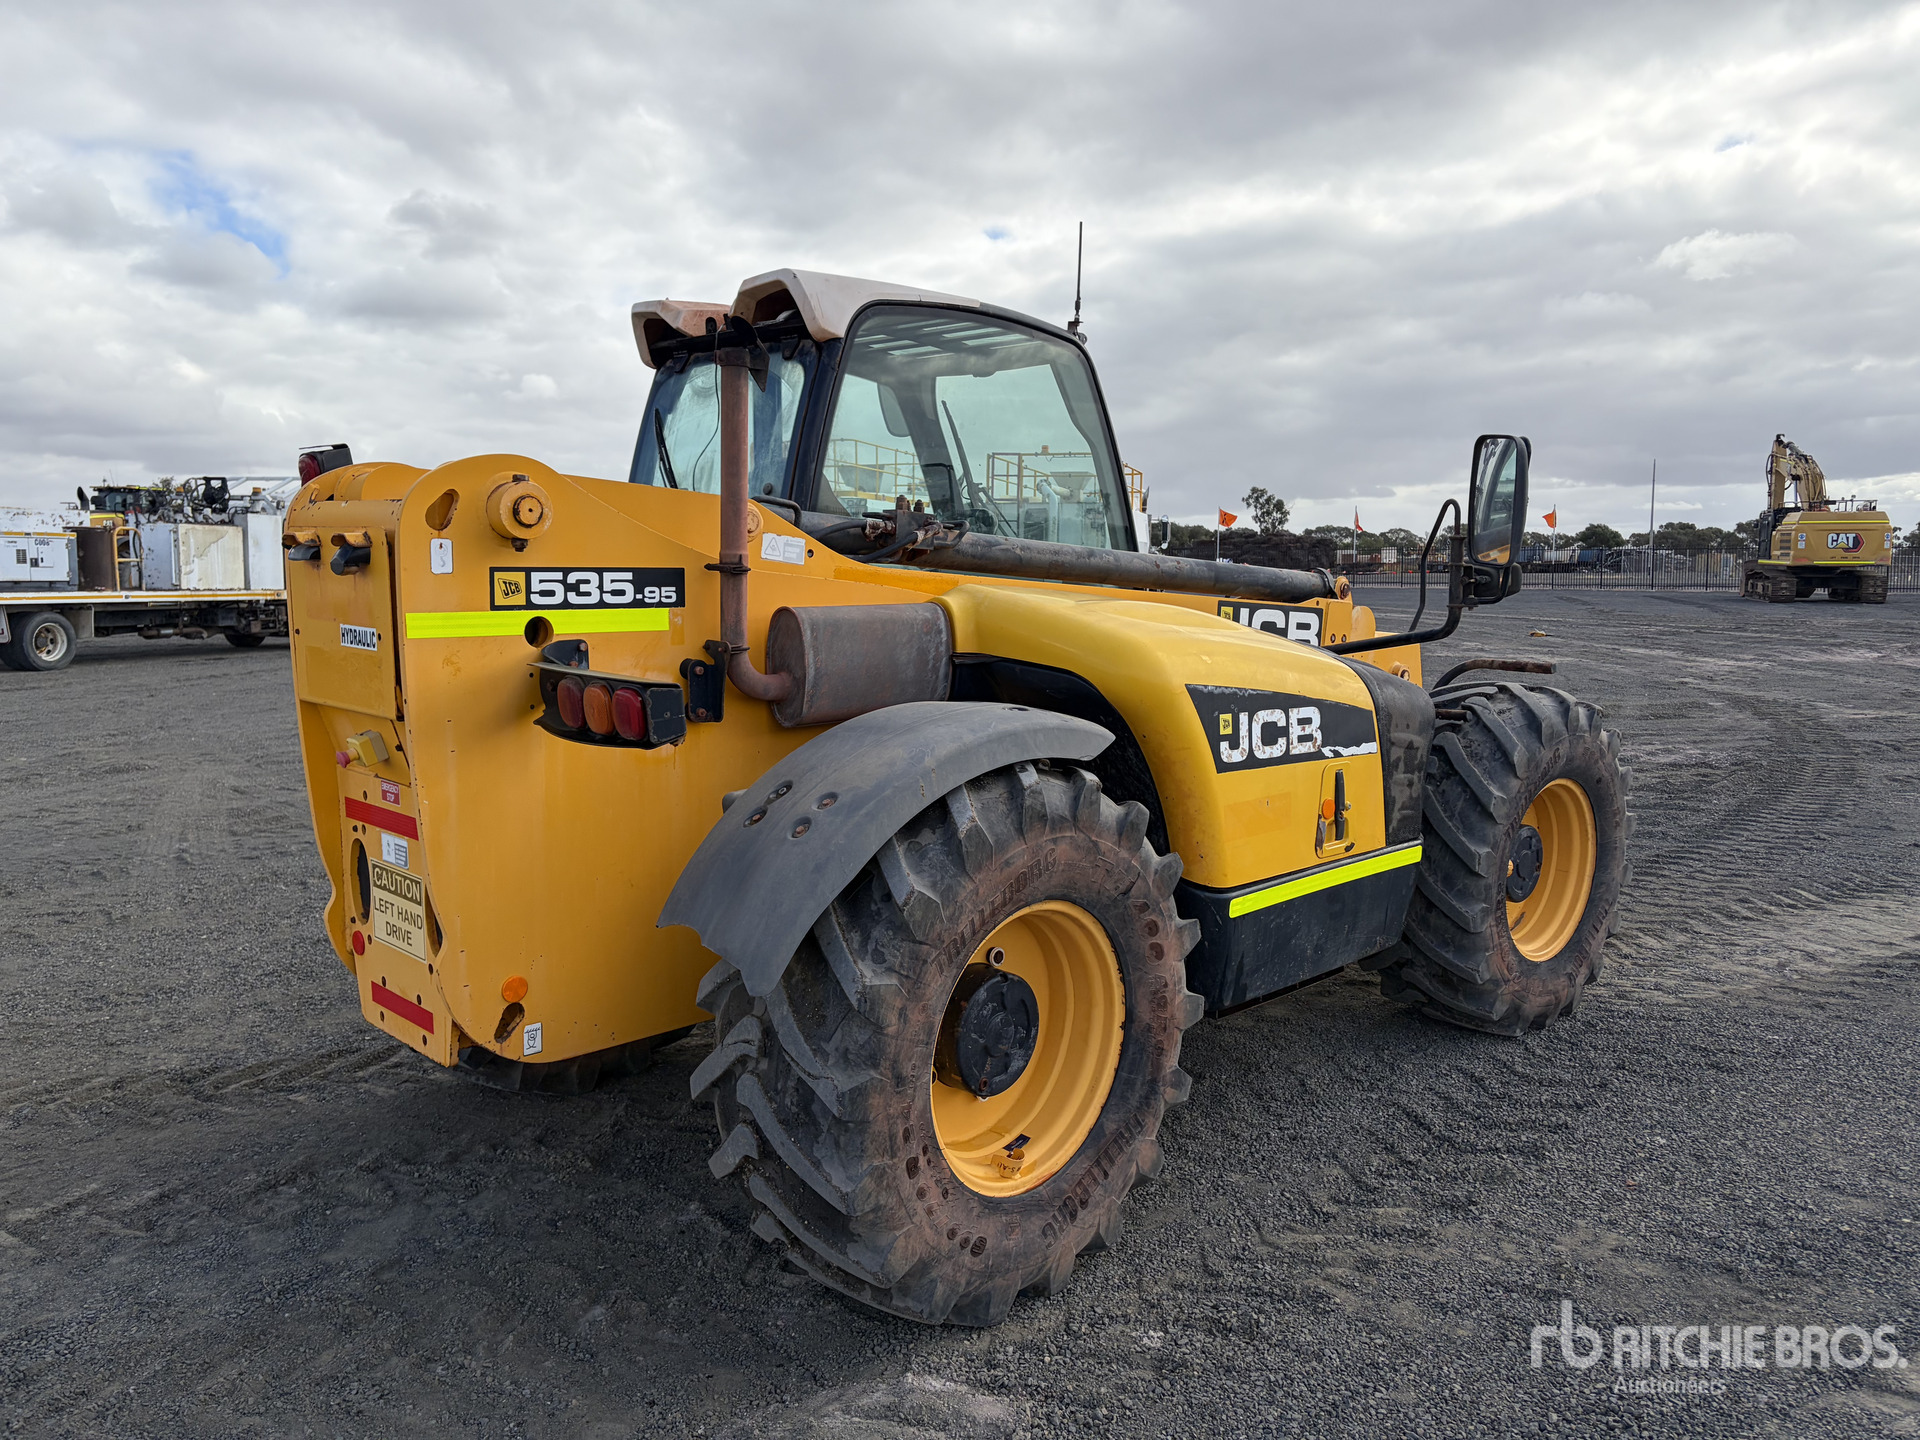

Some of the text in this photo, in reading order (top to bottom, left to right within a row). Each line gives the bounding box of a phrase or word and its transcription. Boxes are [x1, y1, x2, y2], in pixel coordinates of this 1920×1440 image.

[1827, 533, 1856, 549] CAT
[502, 571, 677, 605] JCB 535-95
[341, 627, 376, 649] HYDRAULIC
[1219, 706, 1323, 764] JCB
[374, 867, 420, 902] CAUTION
[373, 895, 423, 930] LEFT HAND
[385, 920, 413, 947] DRIVE
